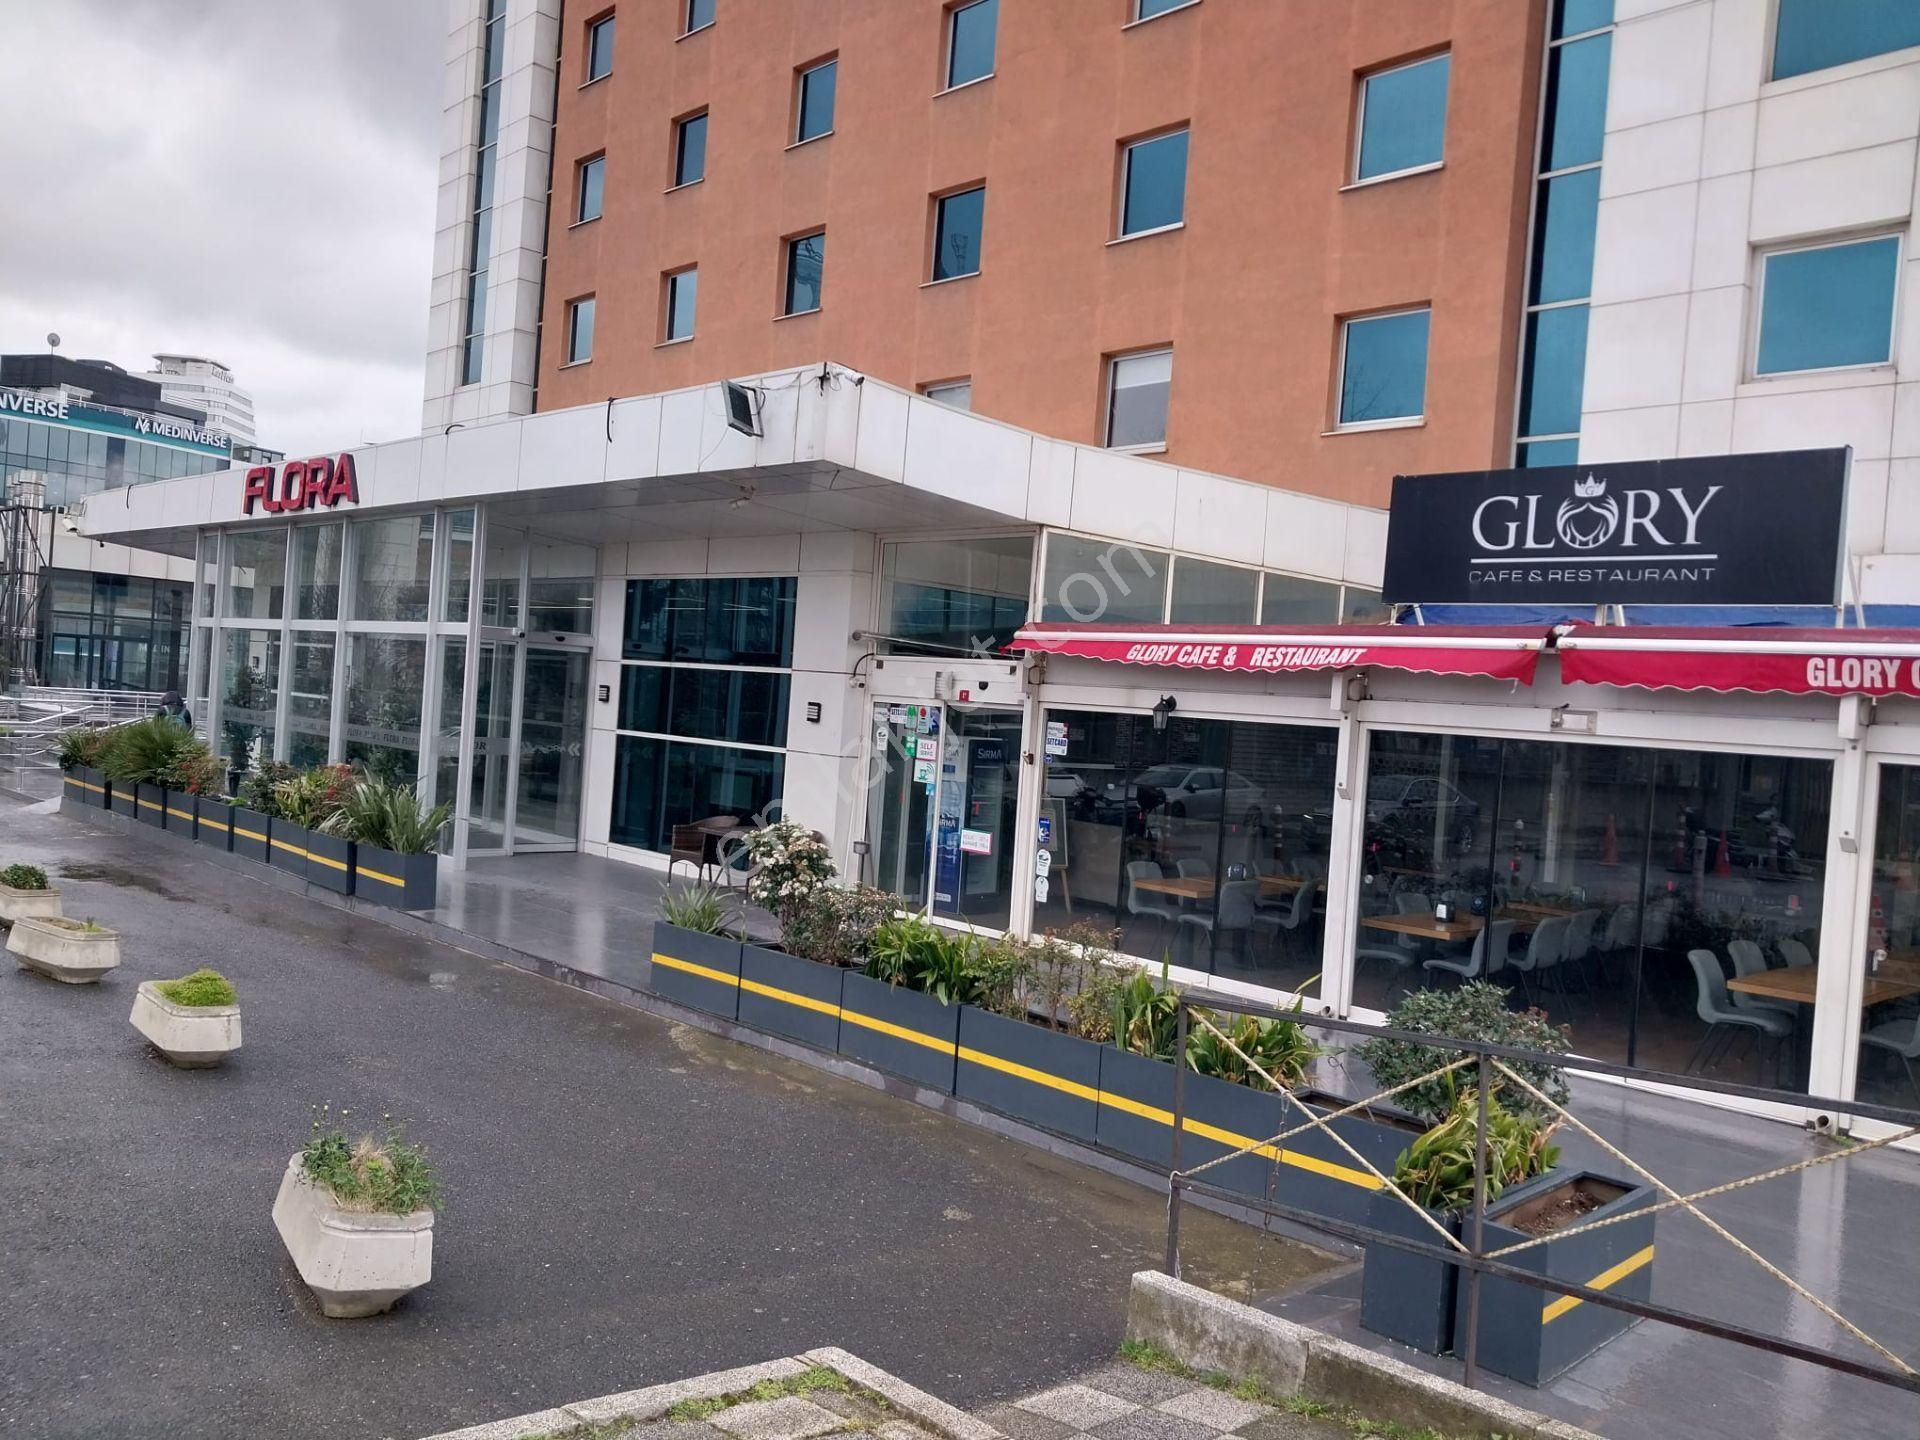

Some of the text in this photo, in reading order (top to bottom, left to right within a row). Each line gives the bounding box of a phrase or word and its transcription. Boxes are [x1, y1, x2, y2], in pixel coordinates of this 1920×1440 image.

[152, 422, 227, 448] MEDINVERSE
[243, 453, 359, 514] FLORA
[1472, 485, 1724, 550] GLORY
[1468, 567, 1717, 583] CAFE & RESTAURANT
[1126, 644, 1367, 667] GLORY CAFE & RESTAURANT
[1806, 657, 1902, 688] GLORY
